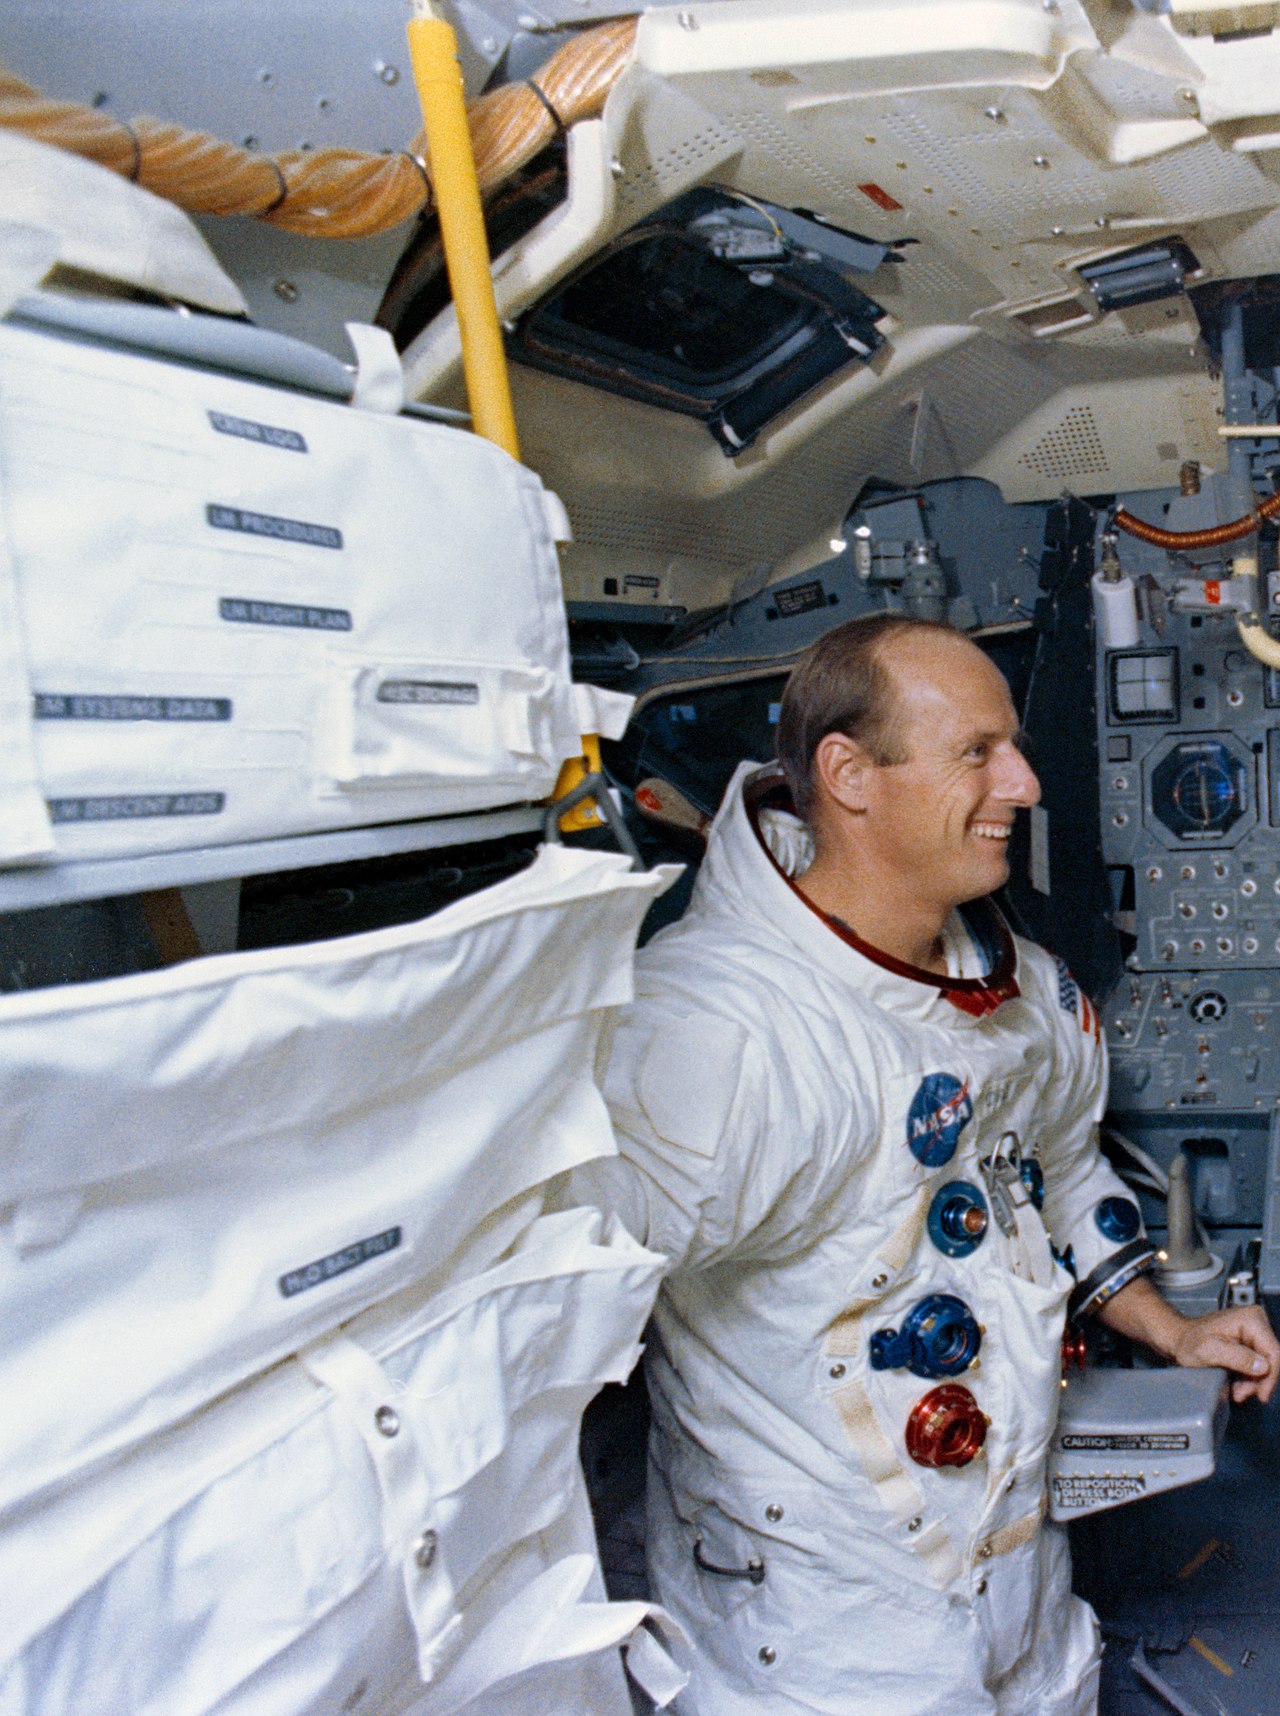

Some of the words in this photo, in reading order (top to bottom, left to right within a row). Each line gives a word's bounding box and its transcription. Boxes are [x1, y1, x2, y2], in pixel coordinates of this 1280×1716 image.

[240, 513, 338, 545] PROCEDURES
[251, 605, 304, 624] FLIGHT
[307, 611, 348, 628] PLAN
[167, 702, 217, 717] DATA
[173, 794, 217, 812] AIDS
[913, 1101, 969, 1137] NASA
[1058, 1479, 1073, 1489] TO
[1062, 1488, 1104, 1498] DEPRESS
